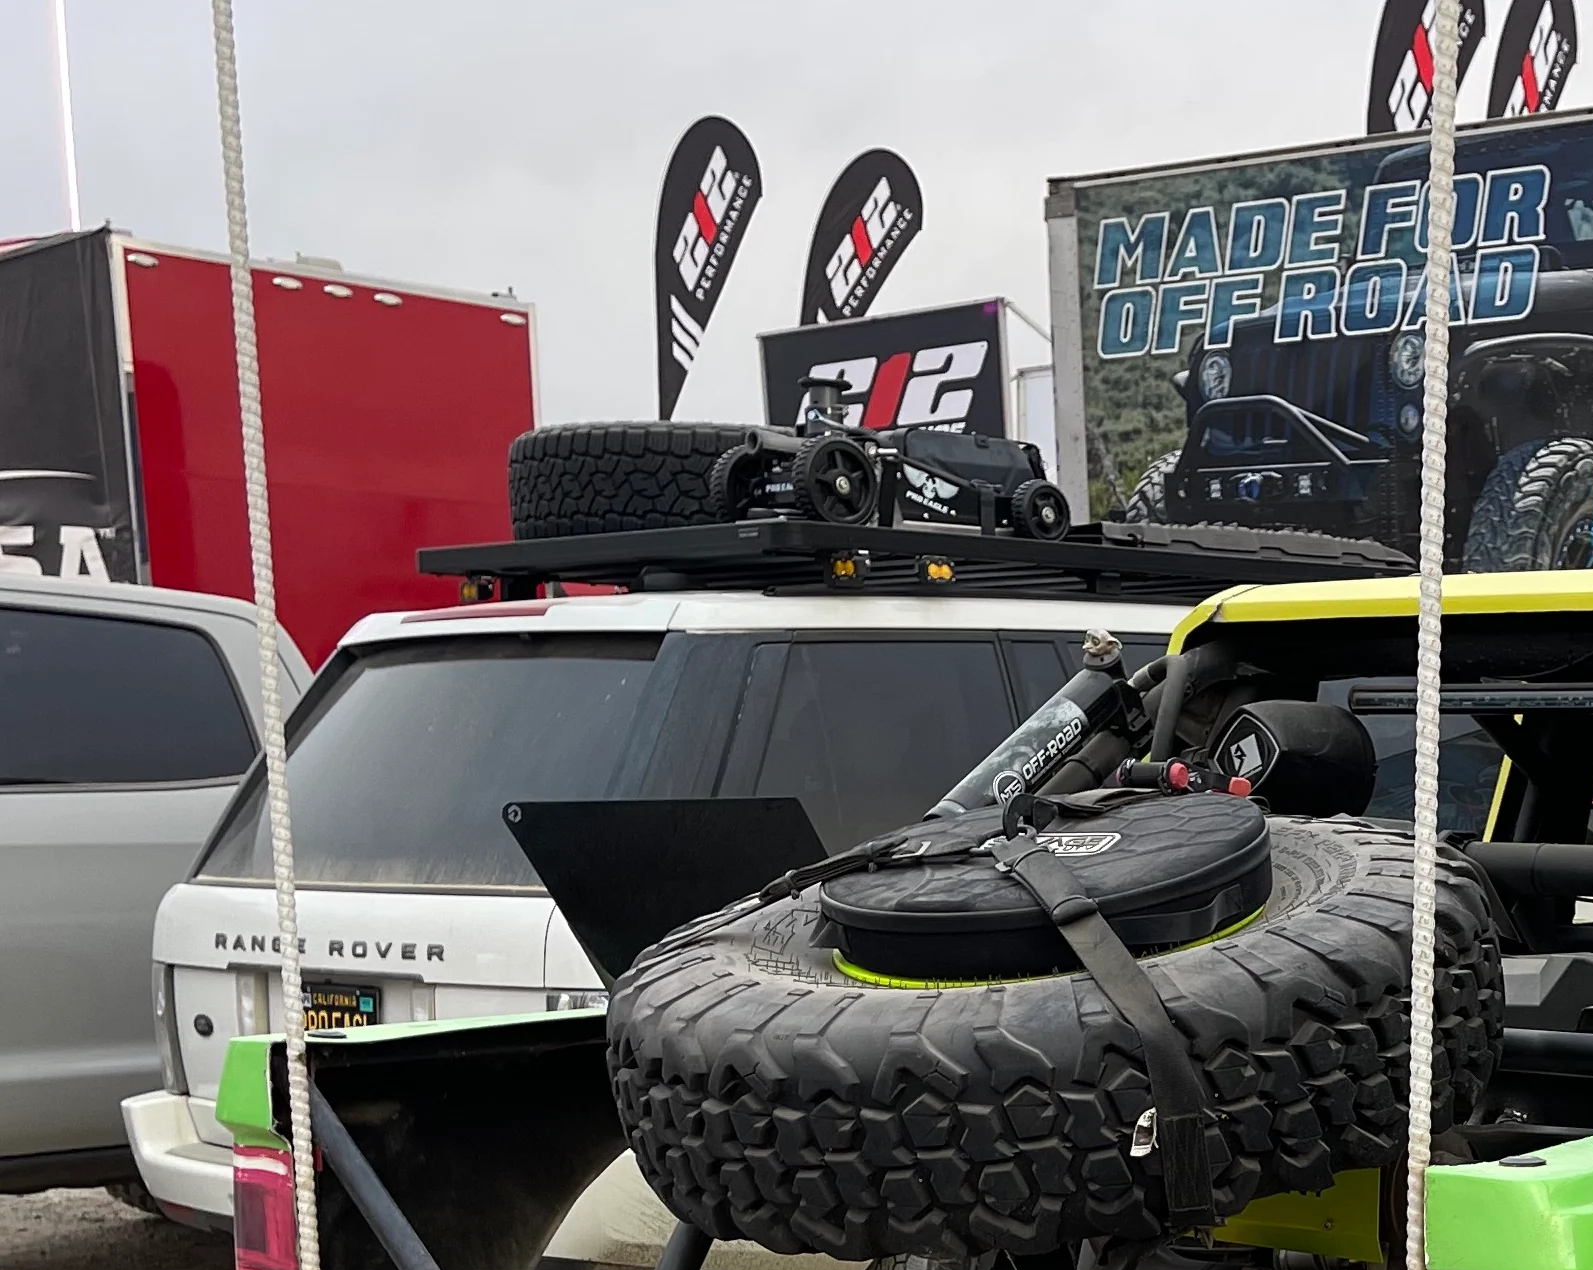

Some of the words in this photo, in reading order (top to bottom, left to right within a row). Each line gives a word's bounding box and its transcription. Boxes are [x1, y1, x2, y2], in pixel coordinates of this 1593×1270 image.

[673, 145, 737, 291] 212
[695, 174, 753, 300] PERFORMANCE
[826, 176, 898, 308] 212
[842, 208, 914, 316] PERFORMANCE
[1094, 188, 1346, 289] MADE
[1357, 164, 1550, 260] FOR
[1098, 273, 1263, 358] OFF
[1274, 244, 1540, 345] ROAD
[215, 933, 306, 954] RANGE
[329, 940, 445, 961] ROVER
[313, 993, 356, 1008] CALIFORNIA
